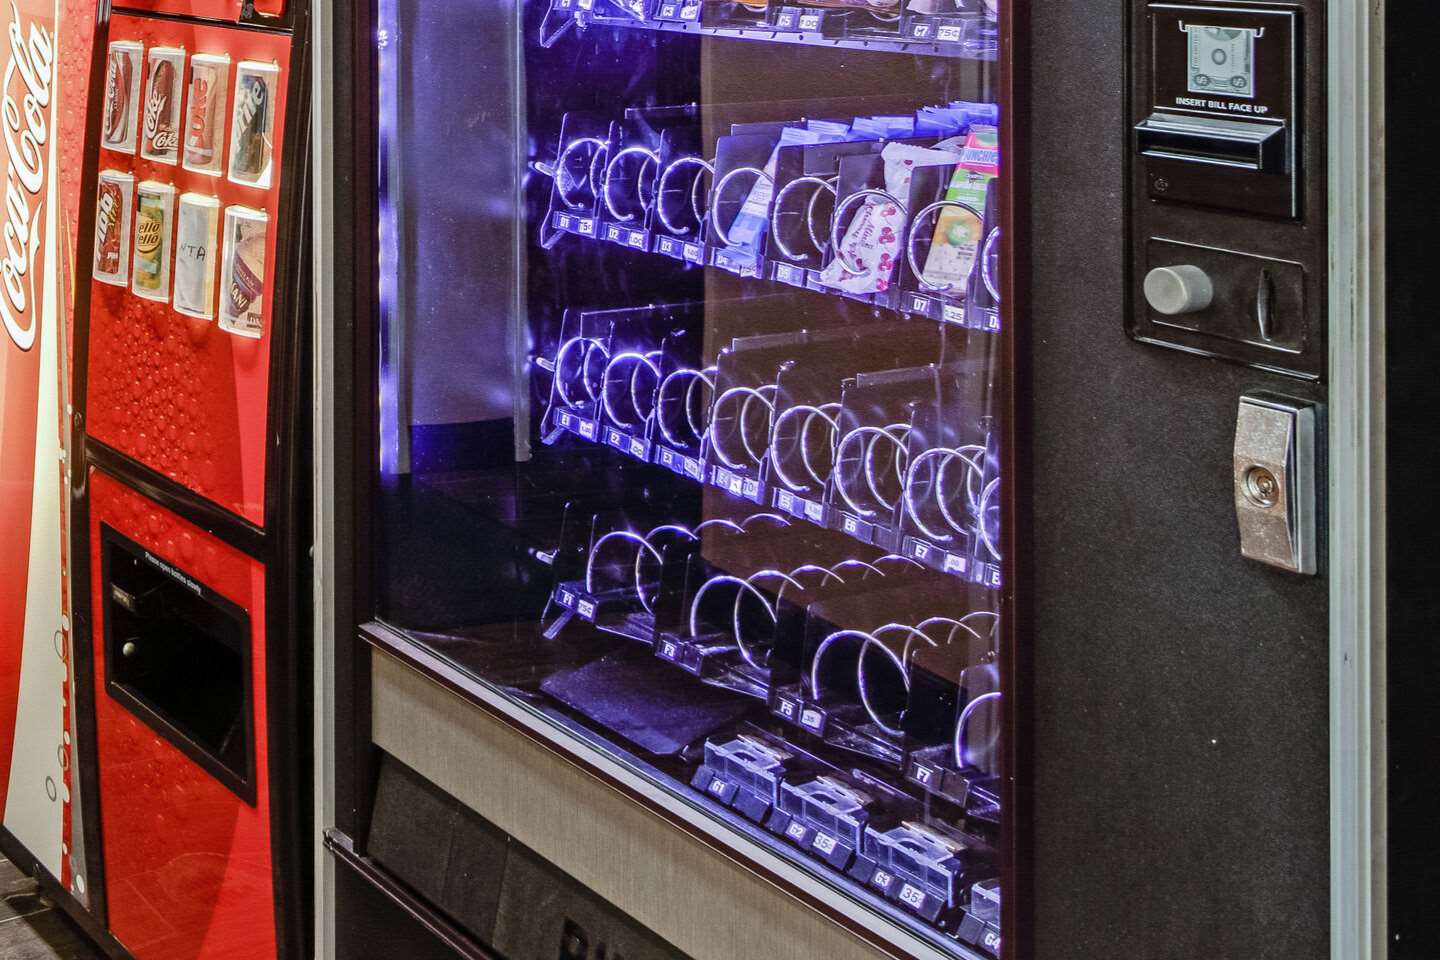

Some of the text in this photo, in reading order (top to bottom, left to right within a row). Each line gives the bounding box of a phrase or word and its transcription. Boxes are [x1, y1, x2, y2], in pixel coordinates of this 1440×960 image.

[1176, 96, 1268, 114] INSERT BILL FACE UP
[845, 519, 856, 532] E6
[781, 704, 792, 716] F5
[916, 767, 930, 782] F7
[712, 781, 725, 794] G1
[790, 823, 804, 839] G2
[875, 871, 889, 887] G3
